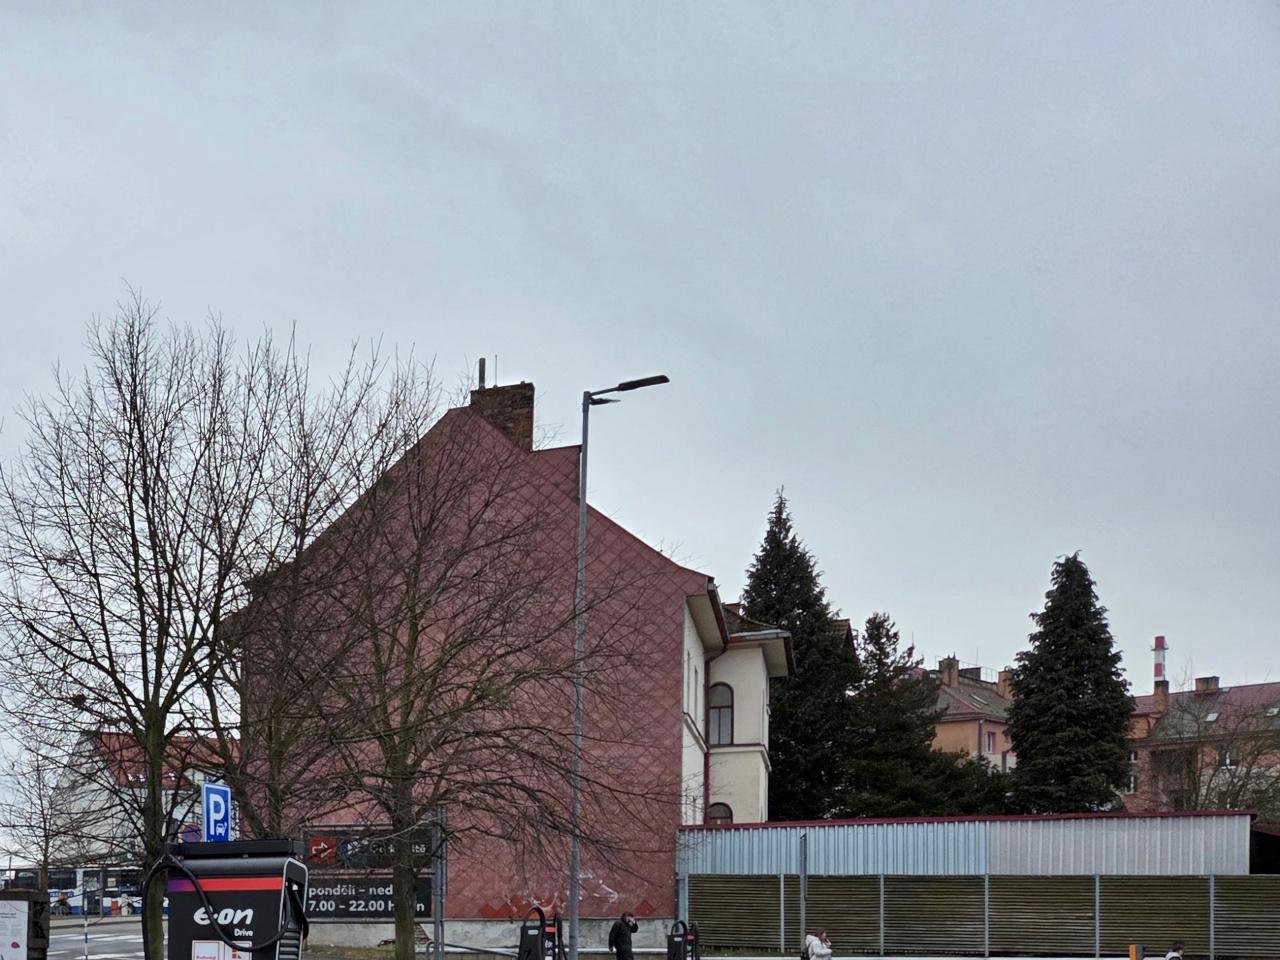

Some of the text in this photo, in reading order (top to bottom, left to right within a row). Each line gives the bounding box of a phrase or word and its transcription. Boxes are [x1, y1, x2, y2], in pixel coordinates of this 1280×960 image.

[209, 793, 226, 836] P
[308, 884, 356, 898] pondělí
[308, 900, 336, 912] 7.00
[348, 900, 385, 912] 22.00
[234, 928, 253, 937] Drive
